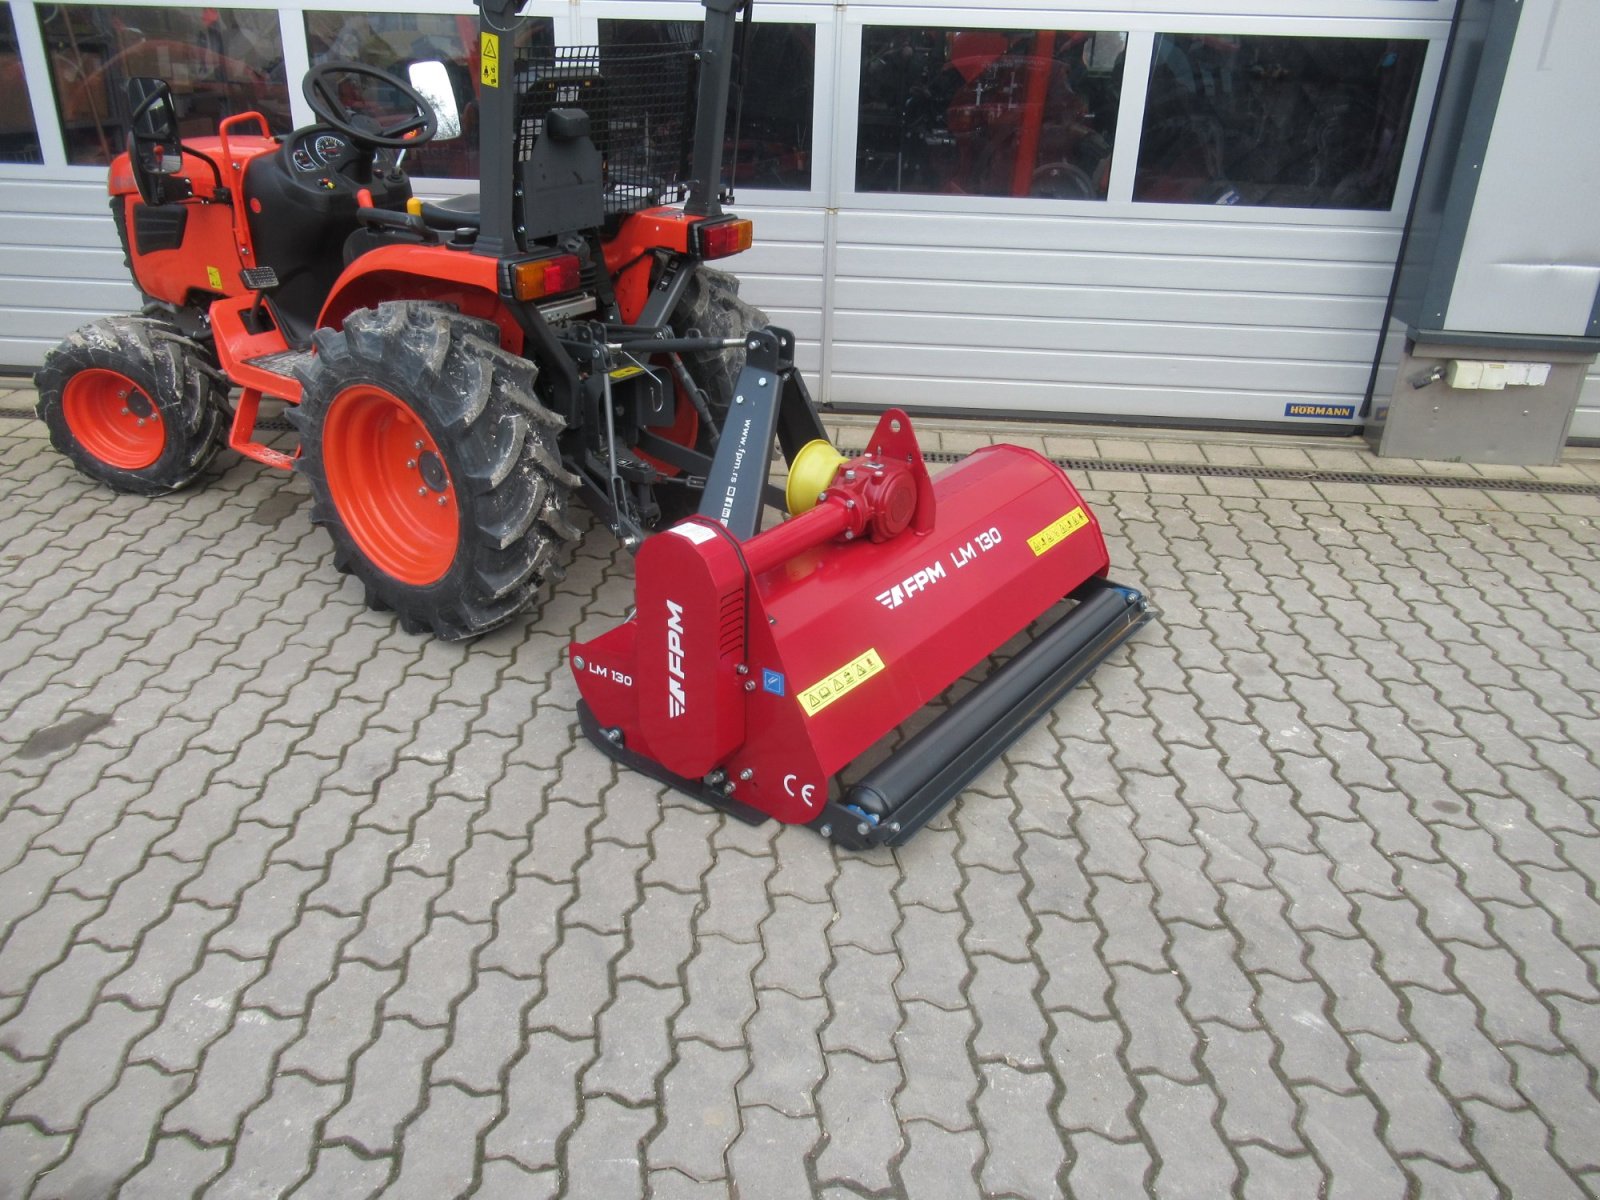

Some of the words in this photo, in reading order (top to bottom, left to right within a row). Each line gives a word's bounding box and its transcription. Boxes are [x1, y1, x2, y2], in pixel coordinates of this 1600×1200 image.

[730, 419, 752, 483] www.fpm.rs
[902, 560, 947, 598] FPM
[950, 541, 977, 569] LM
[974, 527, 1002, 552] 130
[666, 599, 685, 679] FPM
[589, 662, 608, 678] LM
[611, 670, 633, 687] 130
[783, 774, 815, 808] CE
